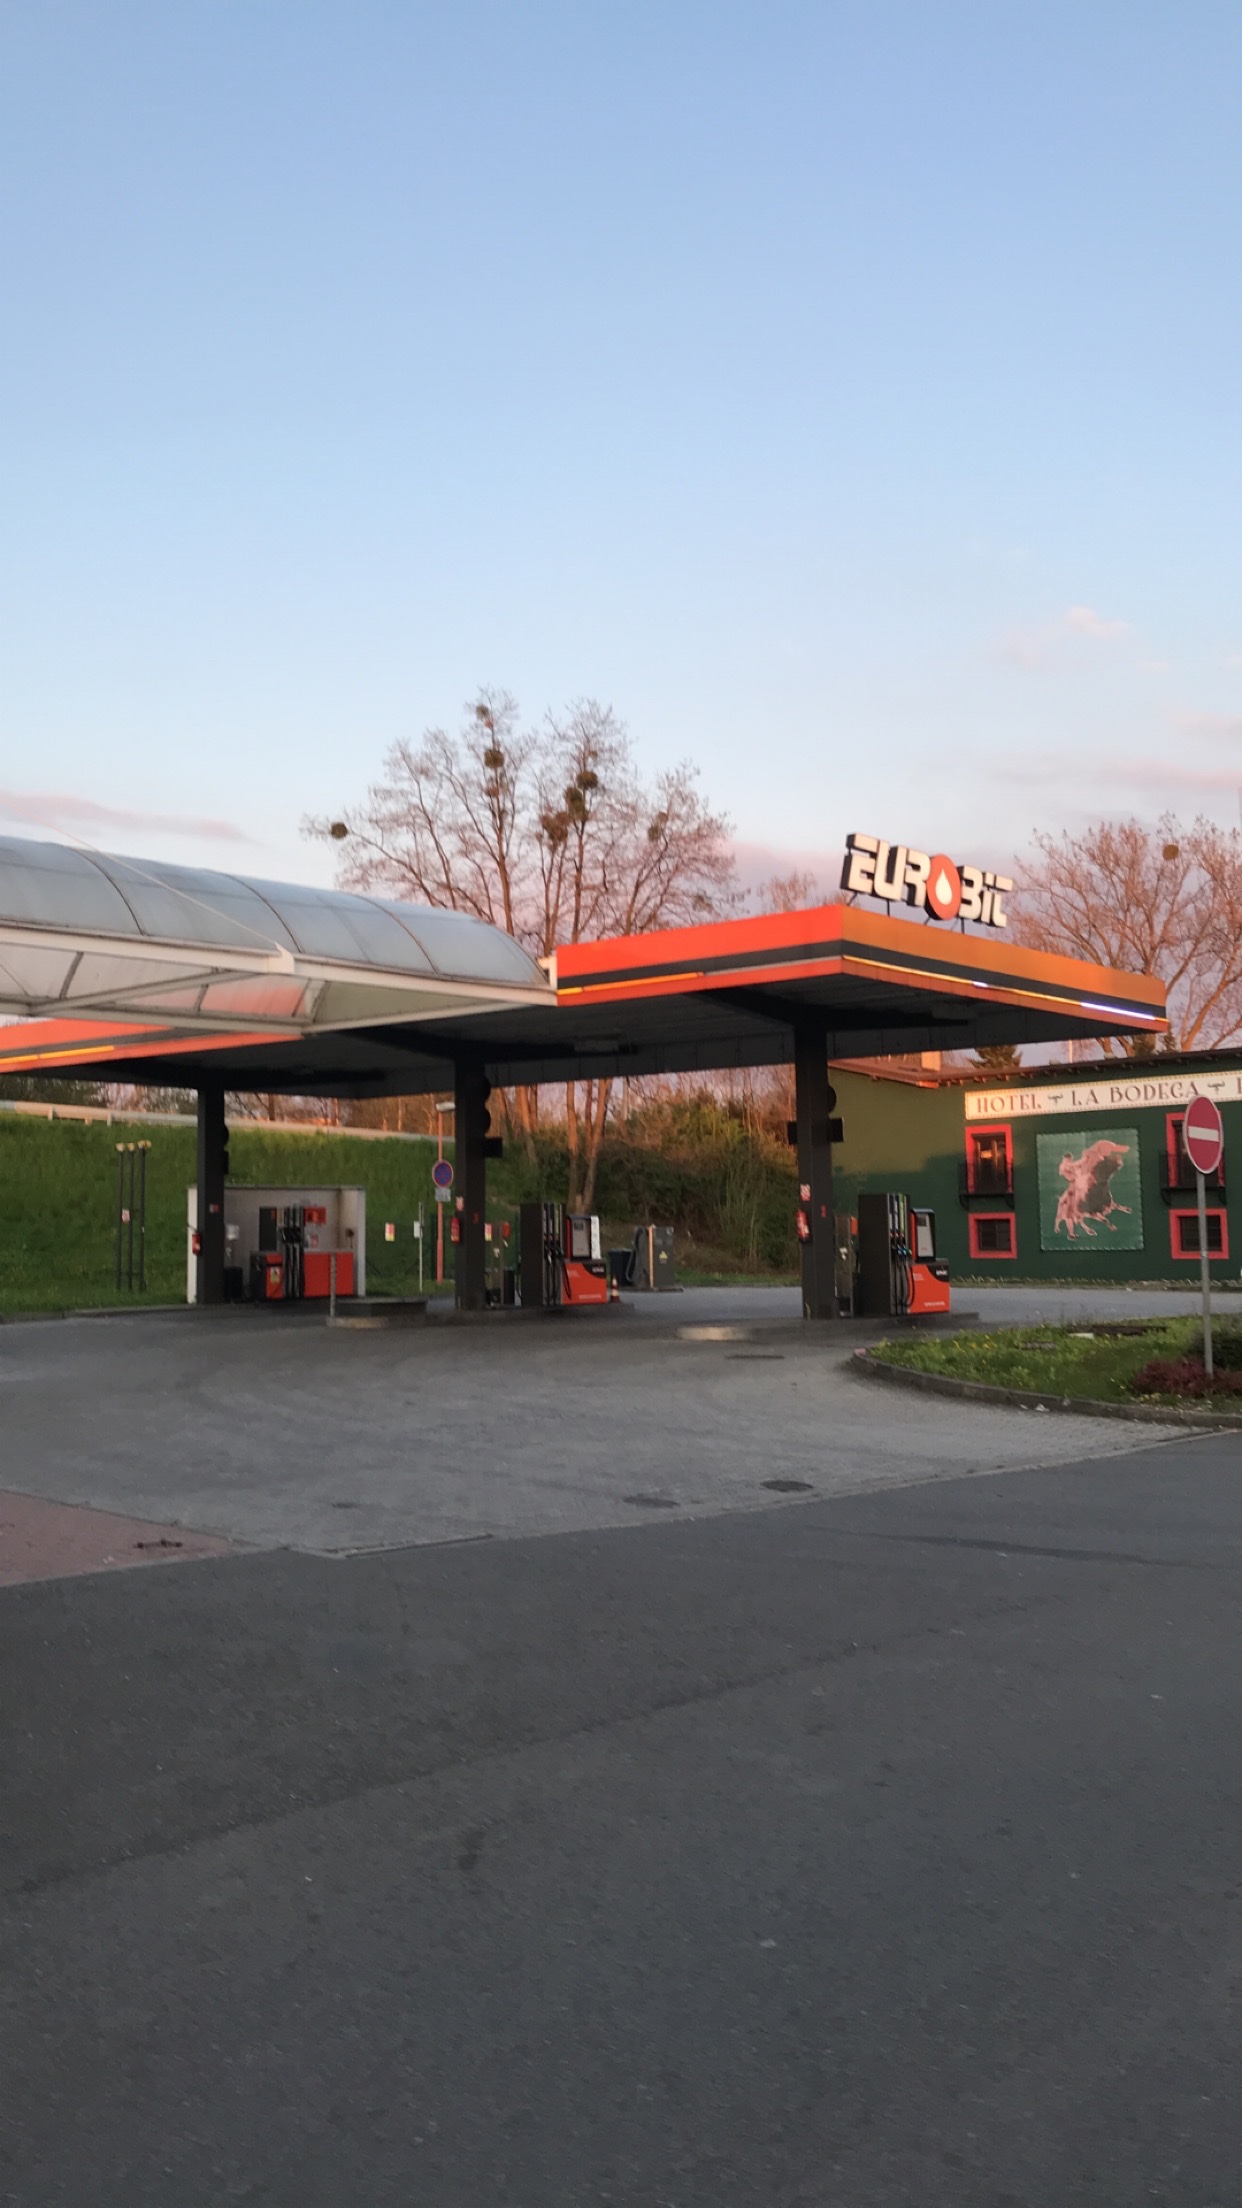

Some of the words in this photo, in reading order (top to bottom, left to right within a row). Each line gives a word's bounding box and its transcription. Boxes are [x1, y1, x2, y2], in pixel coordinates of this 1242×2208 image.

[976, 1093, 1042, 1113] HOTEL
[1071, 1088, 1100, 1106] LA
[1110, 1081, 1199, 1103] BODEGA
